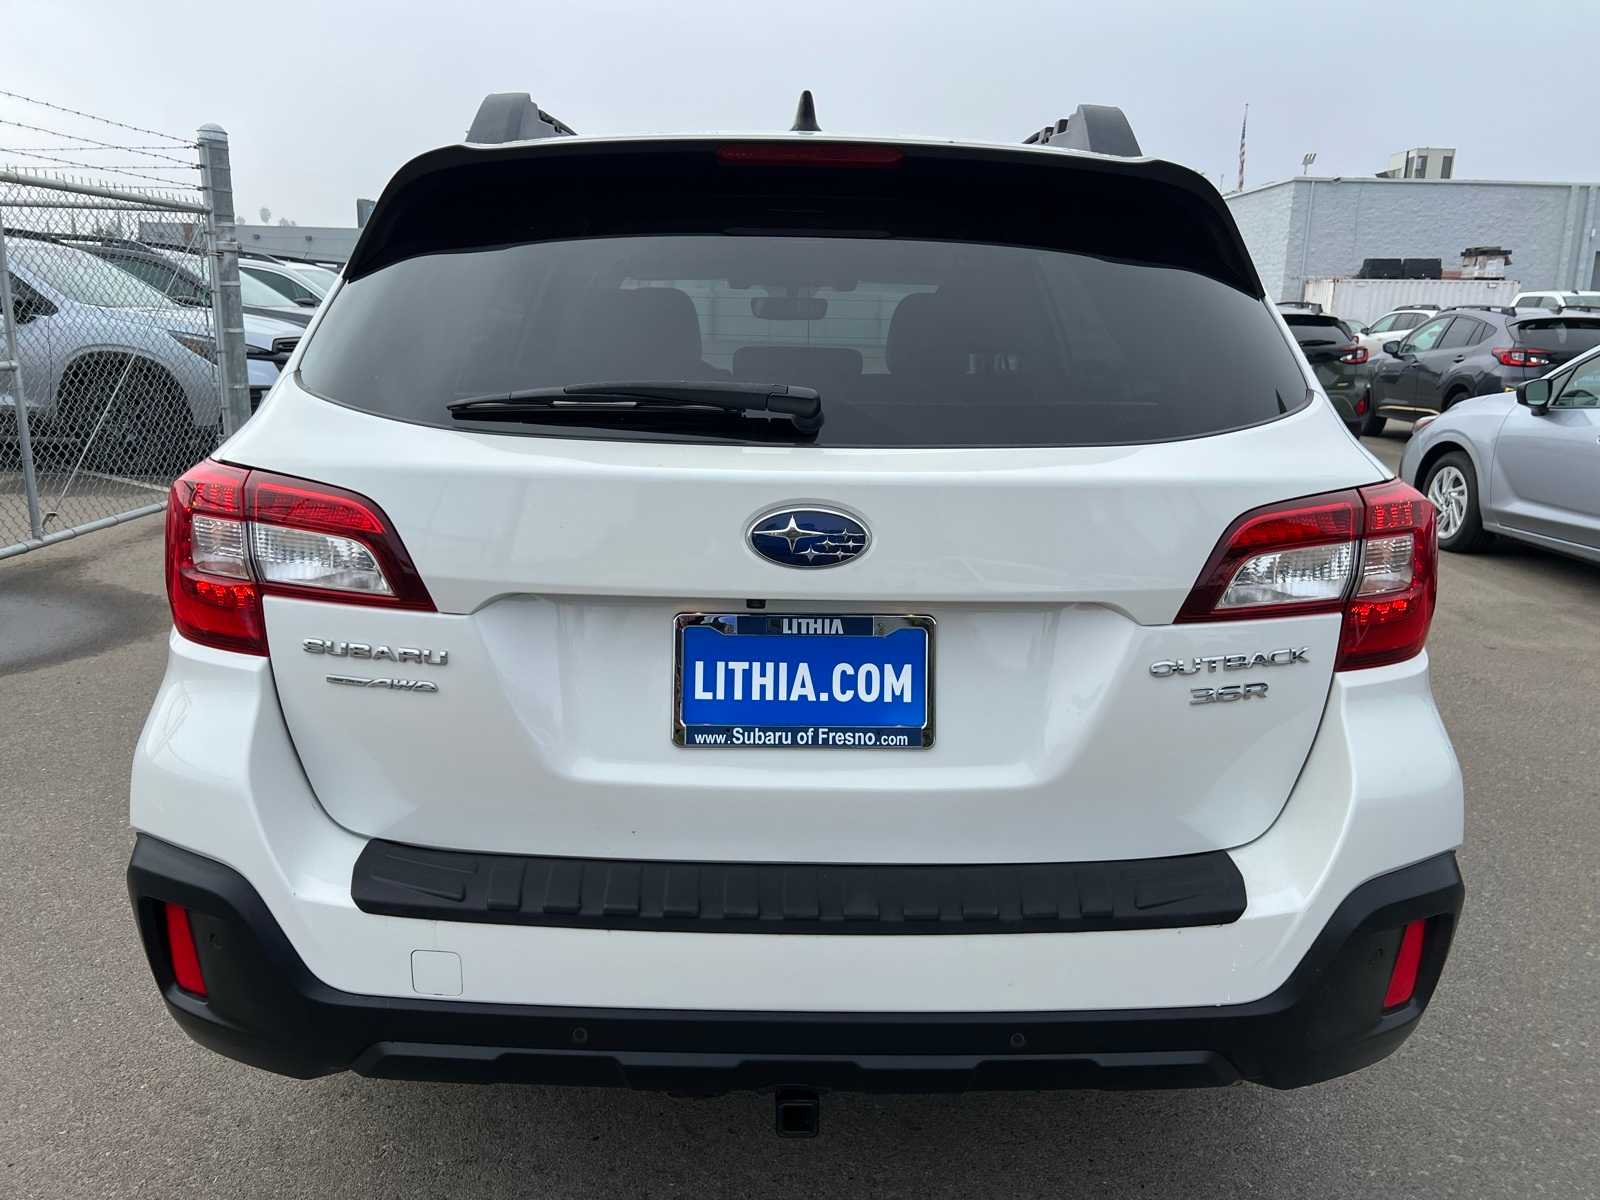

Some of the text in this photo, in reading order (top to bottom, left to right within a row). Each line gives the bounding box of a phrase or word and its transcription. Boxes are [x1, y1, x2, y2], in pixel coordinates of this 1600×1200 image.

[782, 618, 844, 635] LITHIA
[302, 637, 448, 666] SUBARU
[1149, 647, 1309, 678] OUTBACK
[366, 678, 439, 693] AWD
[694, 660, 912, 703] LITHIA.COM
[797, 728, 814, 745] of
[818, 728, 909, 746] Fresno.com
